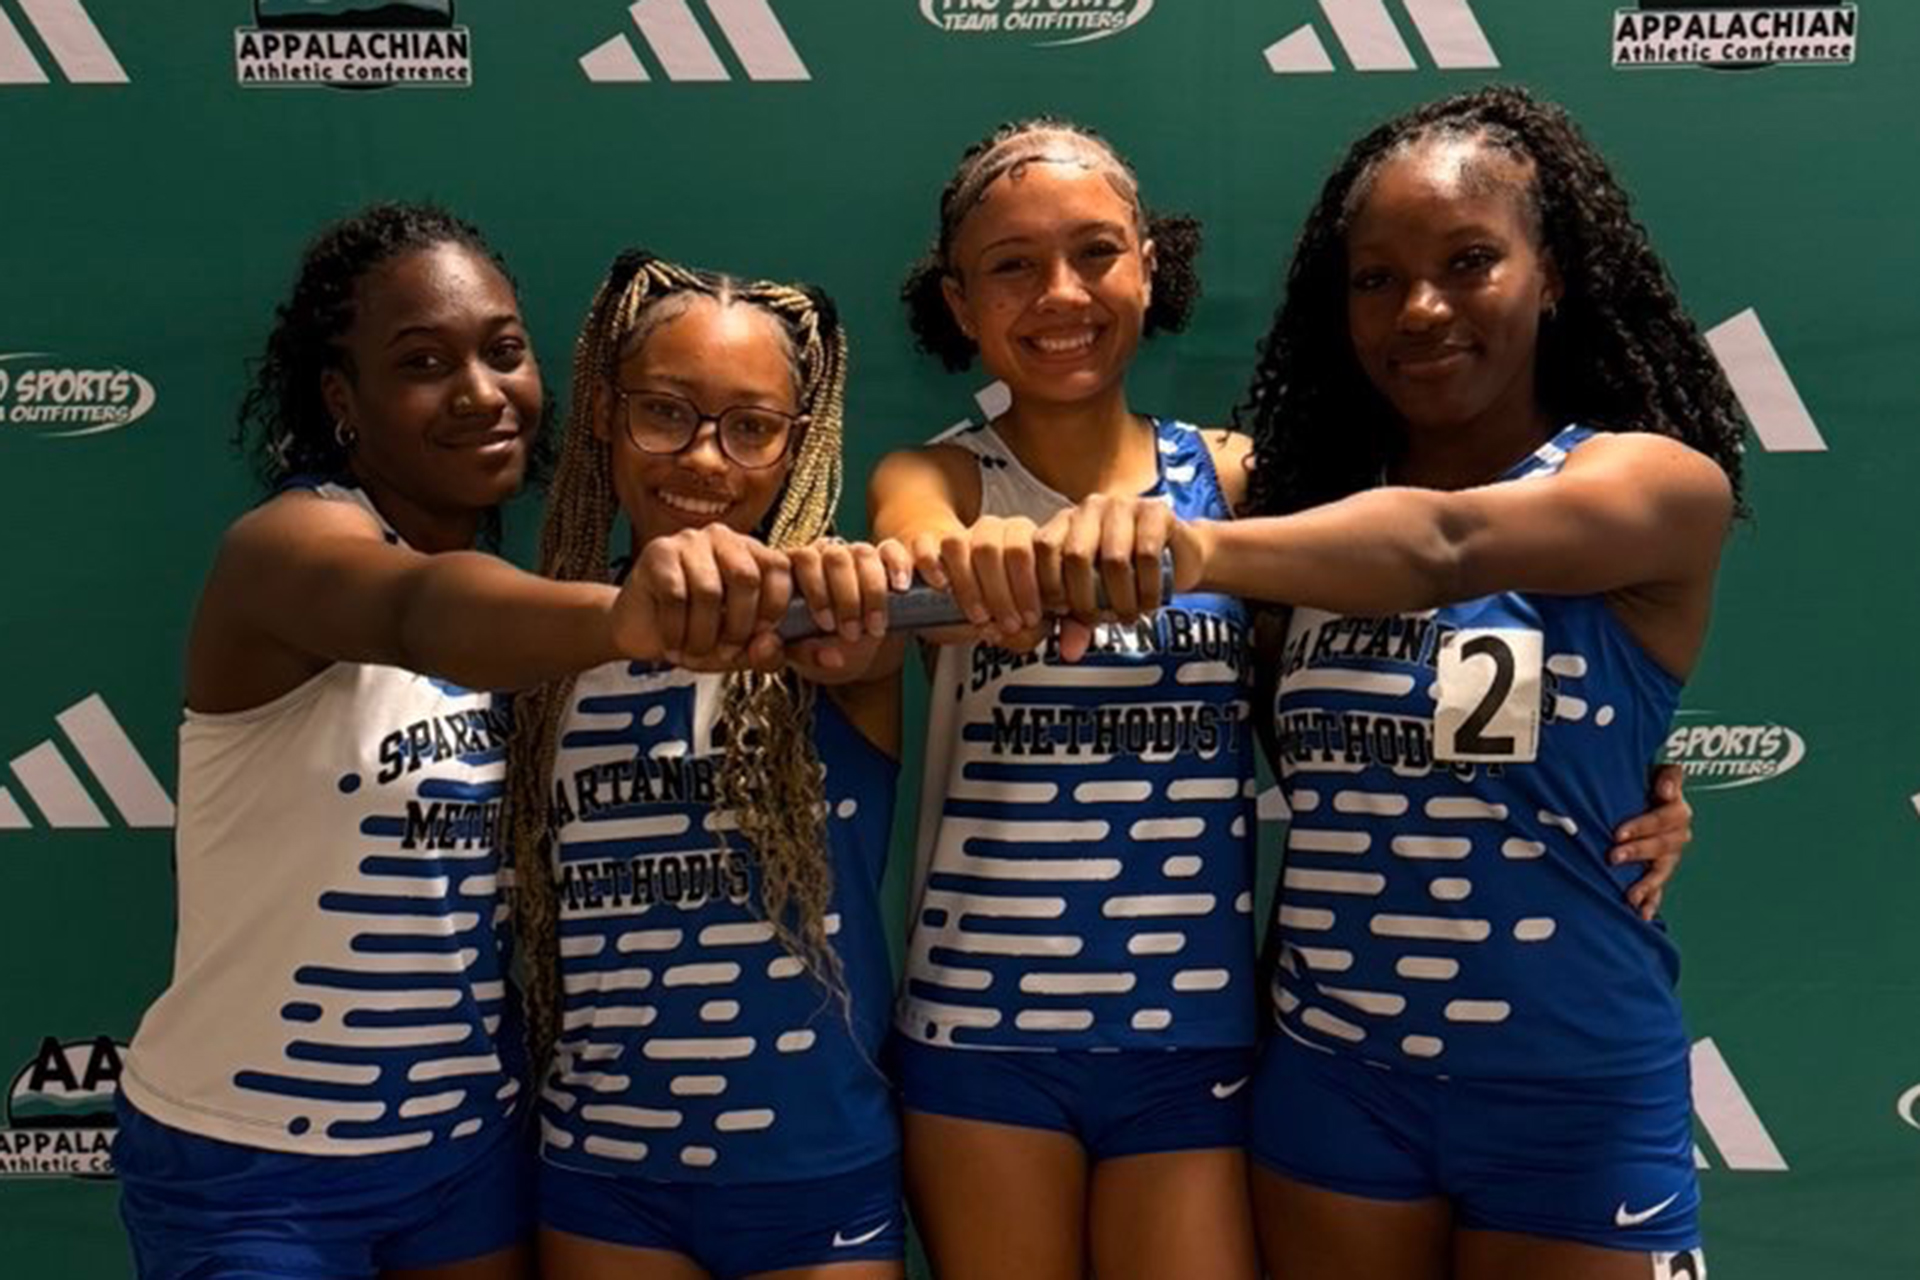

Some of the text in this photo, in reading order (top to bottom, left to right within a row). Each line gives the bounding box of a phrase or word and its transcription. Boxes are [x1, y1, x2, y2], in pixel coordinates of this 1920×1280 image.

[943, 11, 1126, 31] TEAM OUTFITTERS
[1617, 12, 1855, 41] APPALACHIAN
[240, 33, 468, 60] APPALACHIAN
[1617, 40, 1852, 62] Athletic Conference
[243, 62, 468, 82] Athletic Conference
[15, 369, 130, 403] SPORTS
[10, 405, 130, 422] OUTFITTERS
[1453, 634, 1515, 755] 2
[992, 702, 1242, 757] METHODIST
[1665, 724, 1783, 758] SPORTS
[0, 1157, 82, 1173] Athletic
